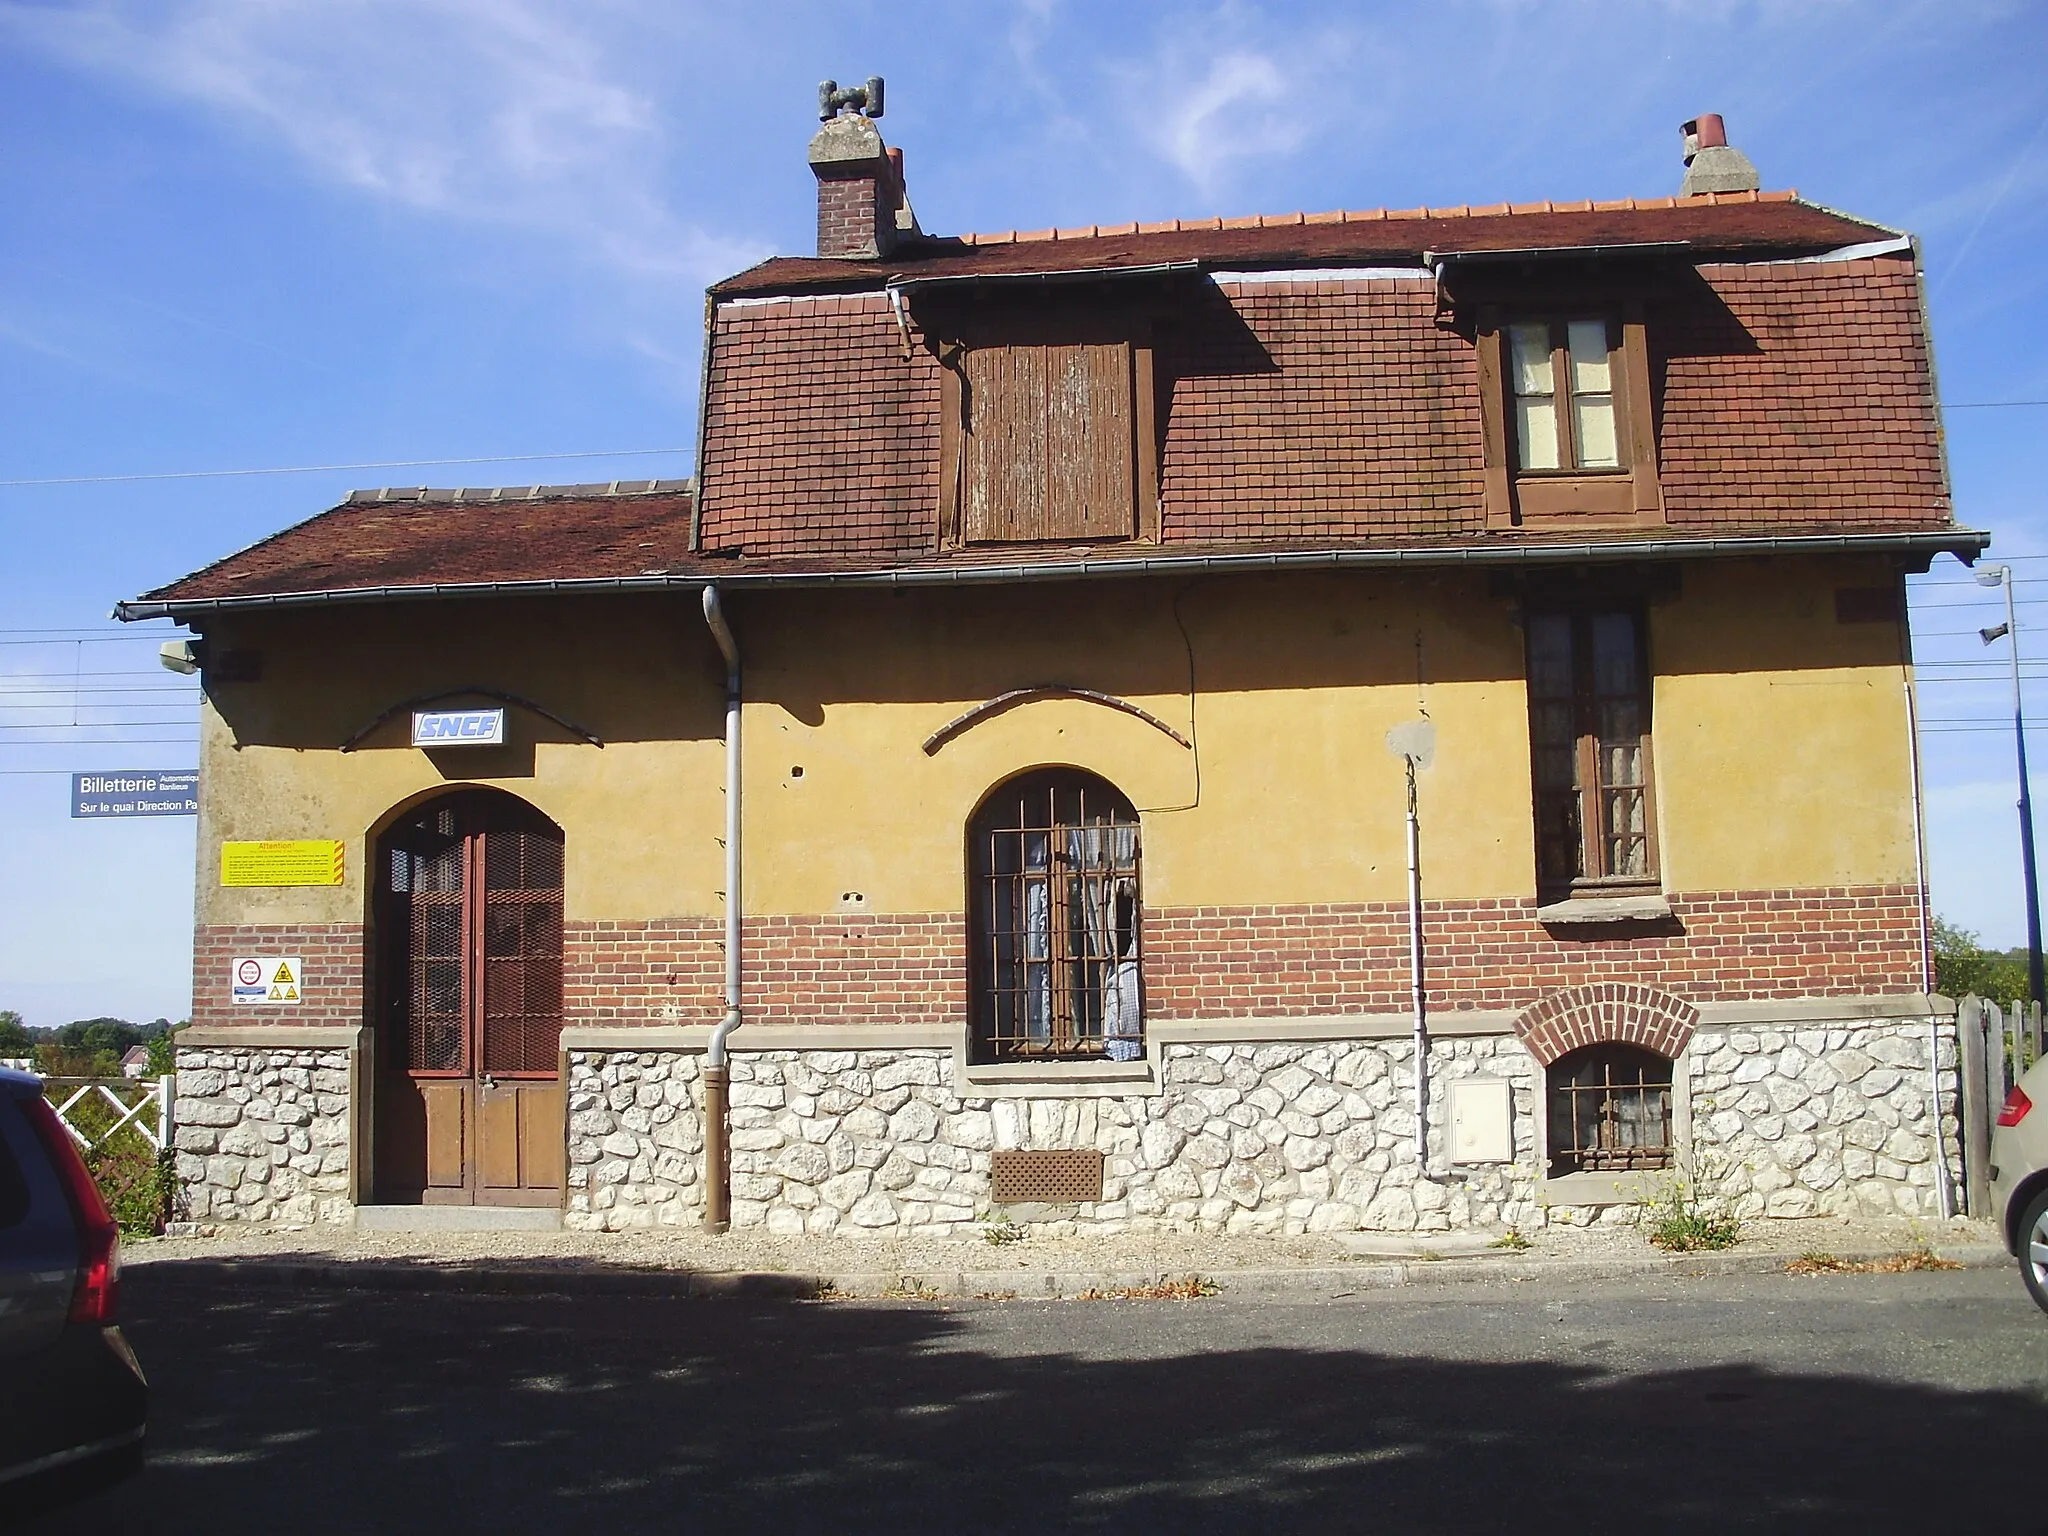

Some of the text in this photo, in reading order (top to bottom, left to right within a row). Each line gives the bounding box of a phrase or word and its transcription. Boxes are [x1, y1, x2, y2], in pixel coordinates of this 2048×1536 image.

[420, 717, 497, 737] SNCF
[80, 776, 157, 793] Billetterie
[80, 802, 98, 813] Sur
[100, 802, 110, 812] le
[113, 801, 135, 814] quai
[137, 800, 182, 811] Direction
